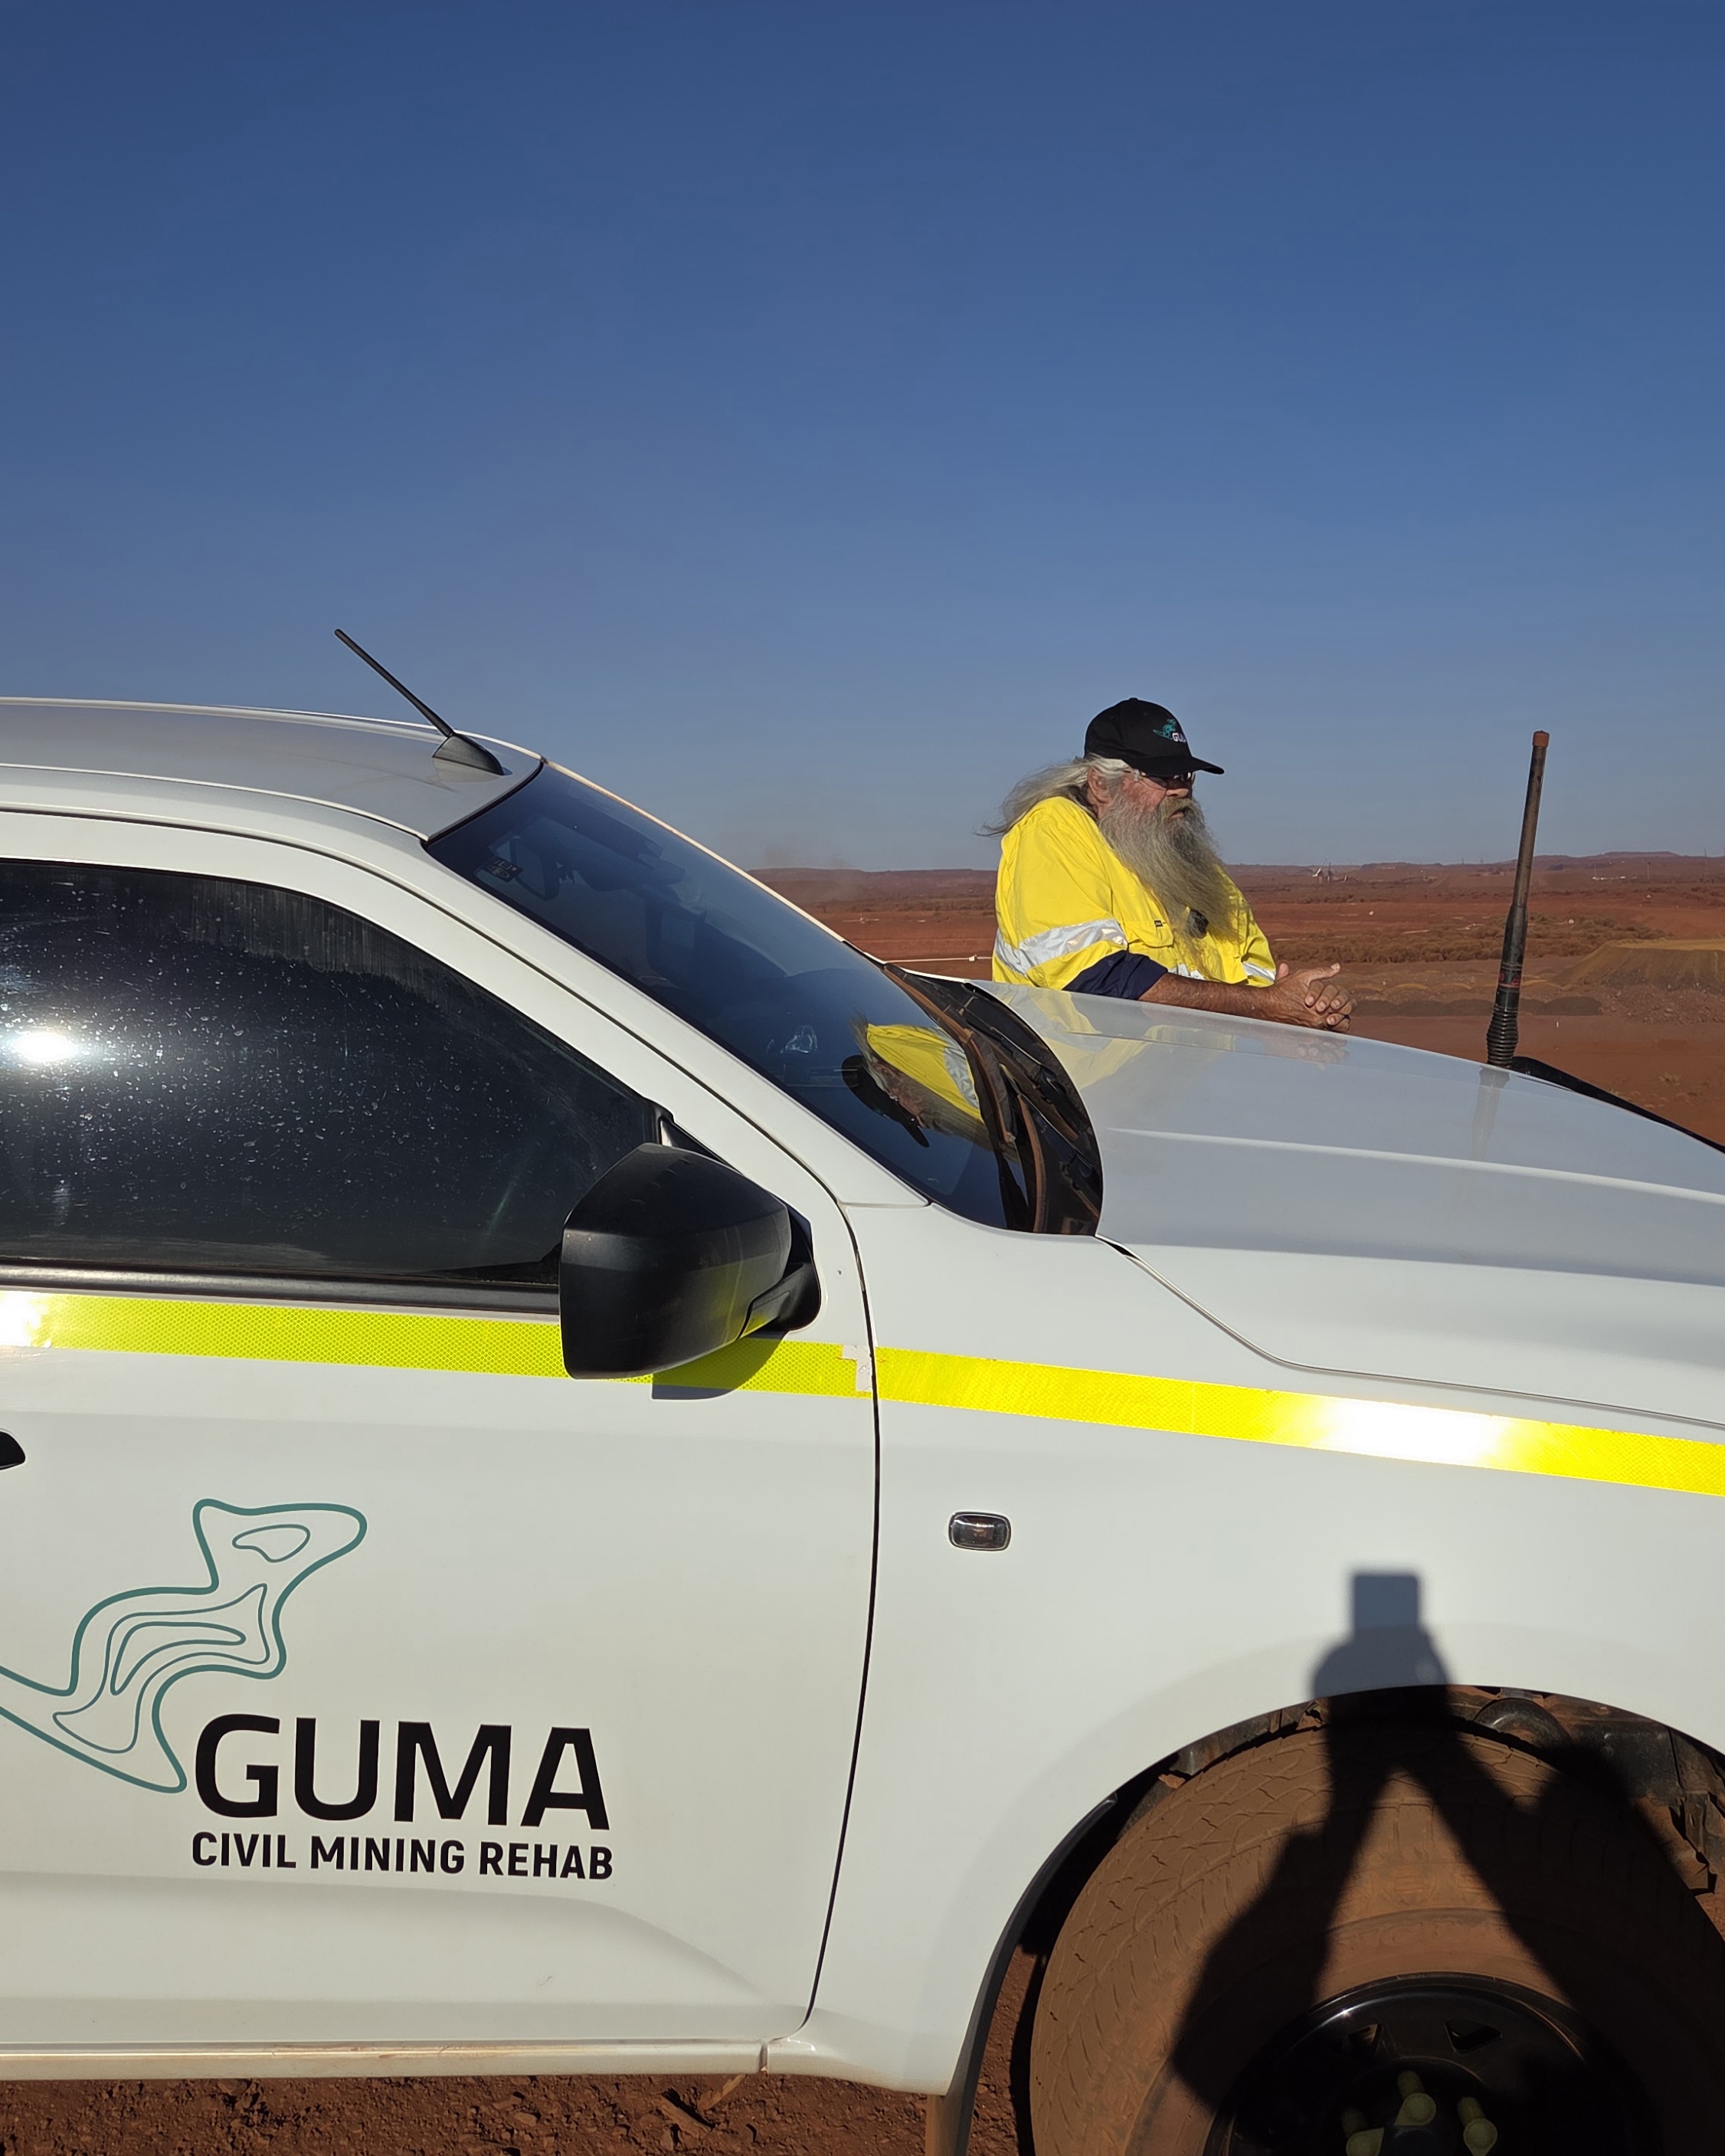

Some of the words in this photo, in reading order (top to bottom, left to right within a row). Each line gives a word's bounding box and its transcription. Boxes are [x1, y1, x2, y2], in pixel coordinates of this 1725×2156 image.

[1172, 732, 1187, 743] GU
[195, 1713, 610, 1830] GUMA
[192, 1831, 297, 1869] CIVIL
[310, 1835, 465, 1874] MINING
[479, 1841, 613, 1880] REHAB
